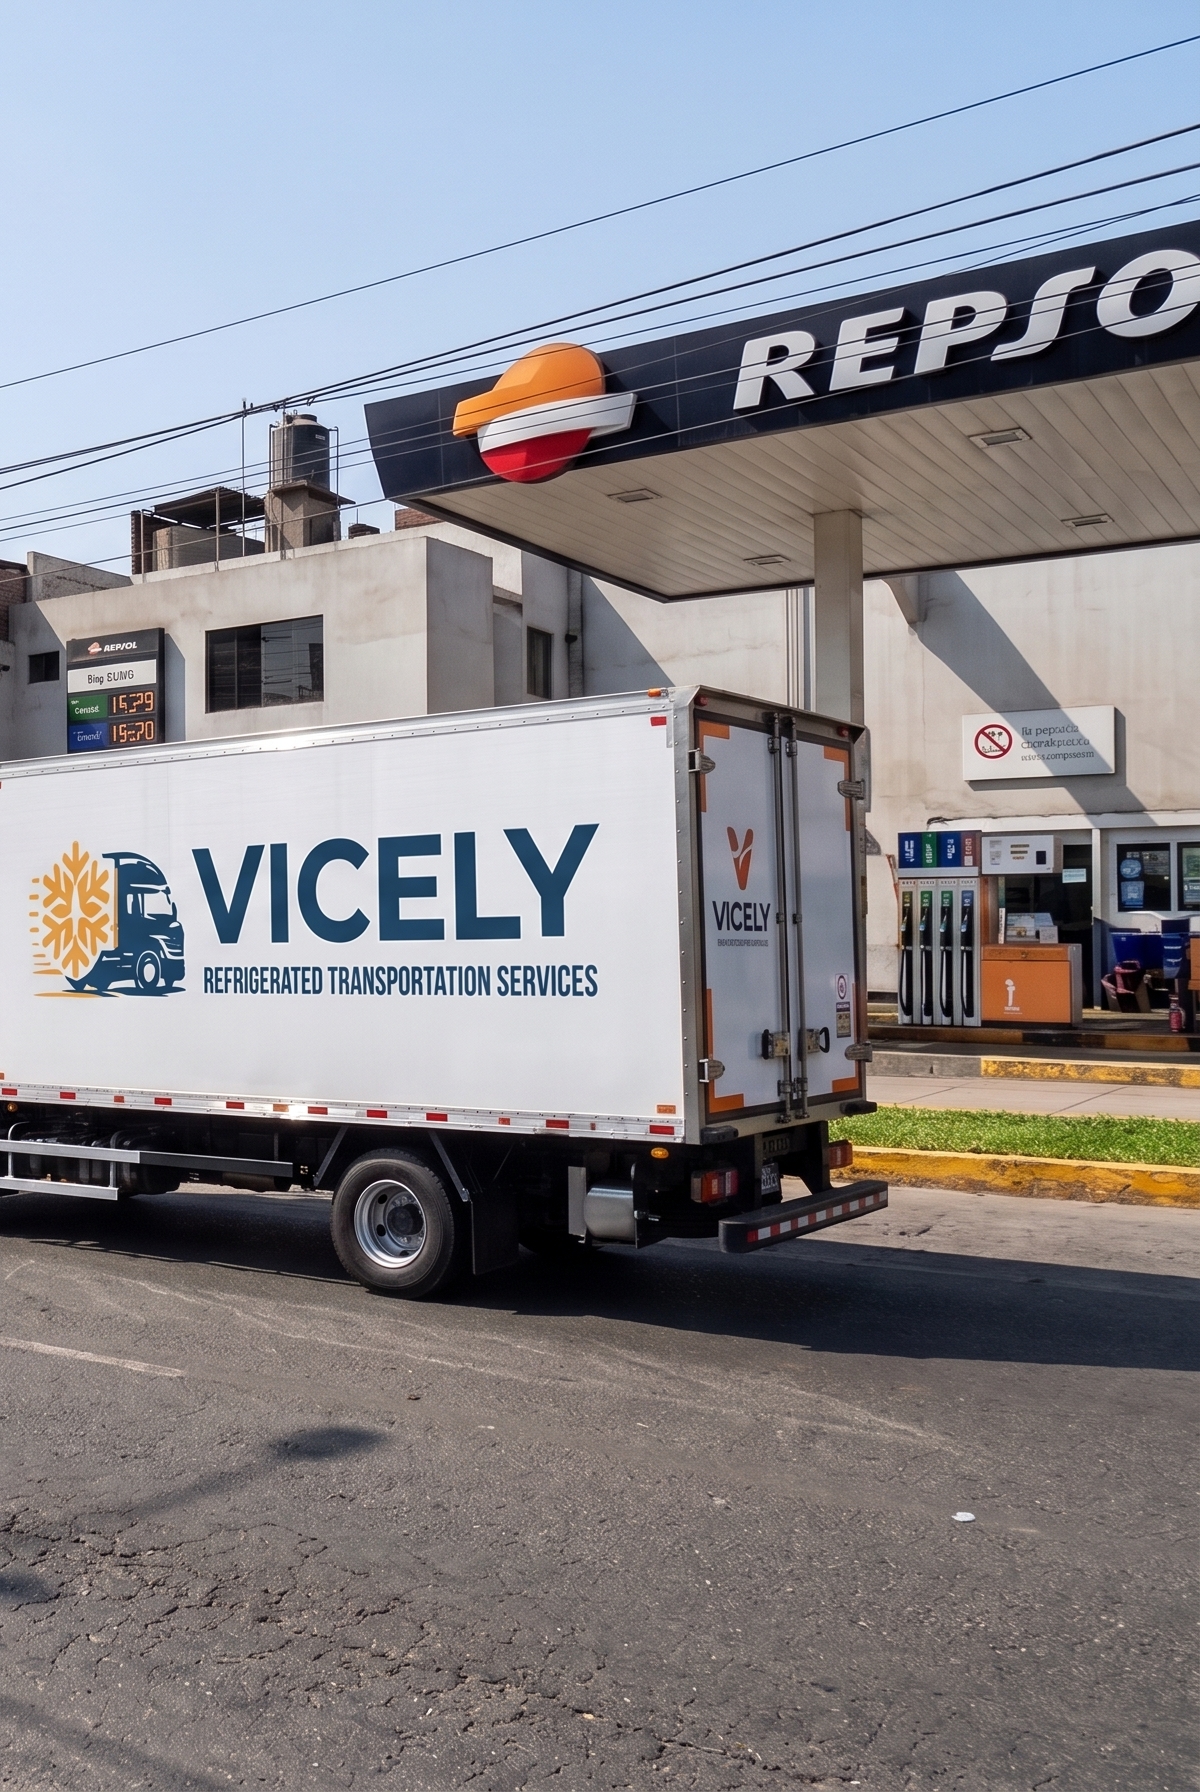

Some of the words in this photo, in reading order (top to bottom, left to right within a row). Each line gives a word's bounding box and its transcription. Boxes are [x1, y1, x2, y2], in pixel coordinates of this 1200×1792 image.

[191, 822, 600, 945] VICELY
[711, 900, 771, 932] VICELY
[203, 966, 323, 995] REFRIGERATED
[327, 965, 491, 997] TRANSPORTATION
[496, 964, 599, 998] SERVICES
